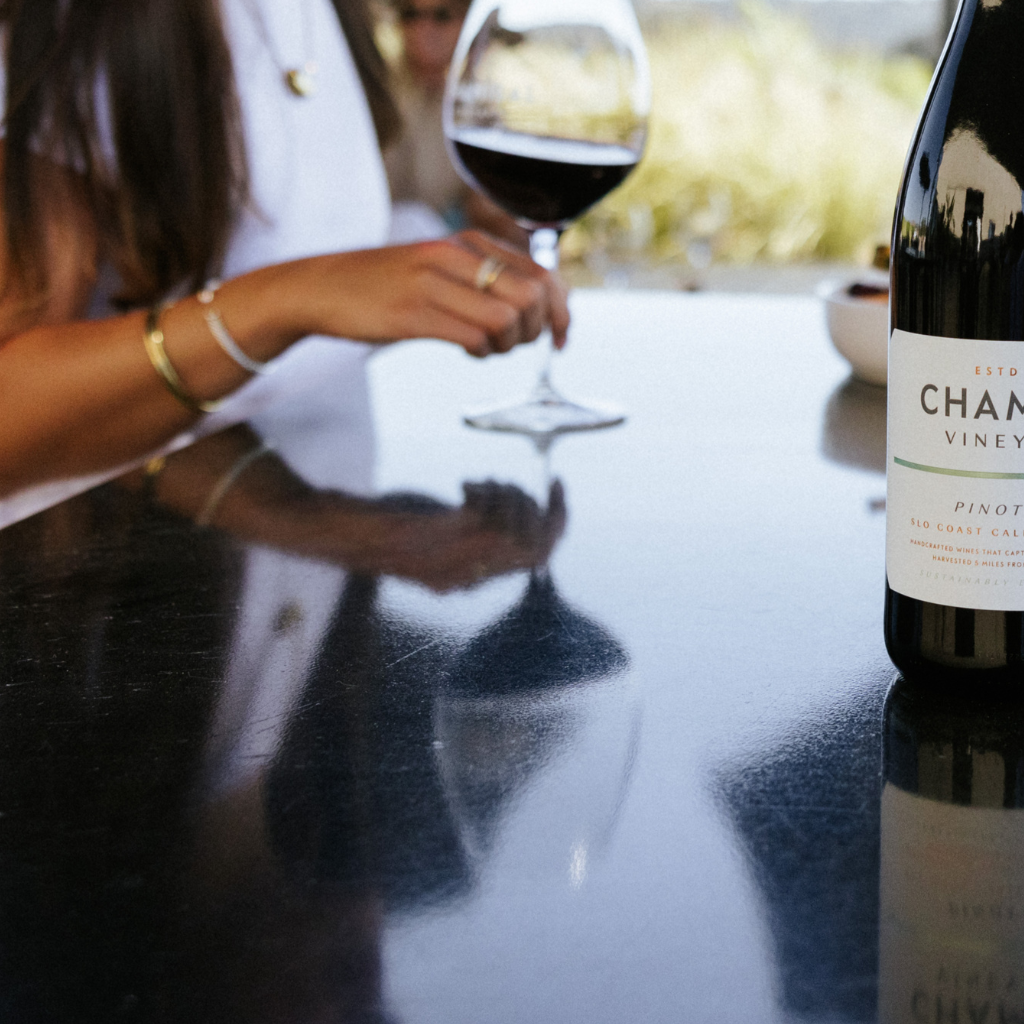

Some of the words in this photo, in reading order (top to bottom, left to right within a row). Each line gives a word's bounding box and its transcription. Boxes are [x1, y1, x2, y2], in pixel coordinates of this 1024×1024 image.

[975, 366, 1017, 376] ESTD
[954, 501, 1023, 516] PINOT
[910, 518, 930, 529] SLO
[937, 523, 982, 535] COAST
[910, 538, 954, 552] HANDCRAFTED
[956, 546, 979, 555] WINES
[932, 555, 972, 566] HARVESTED
[982, 560, 1004, 568] MILES
[919, 569, 1009, 586] SUSTAINABLY
